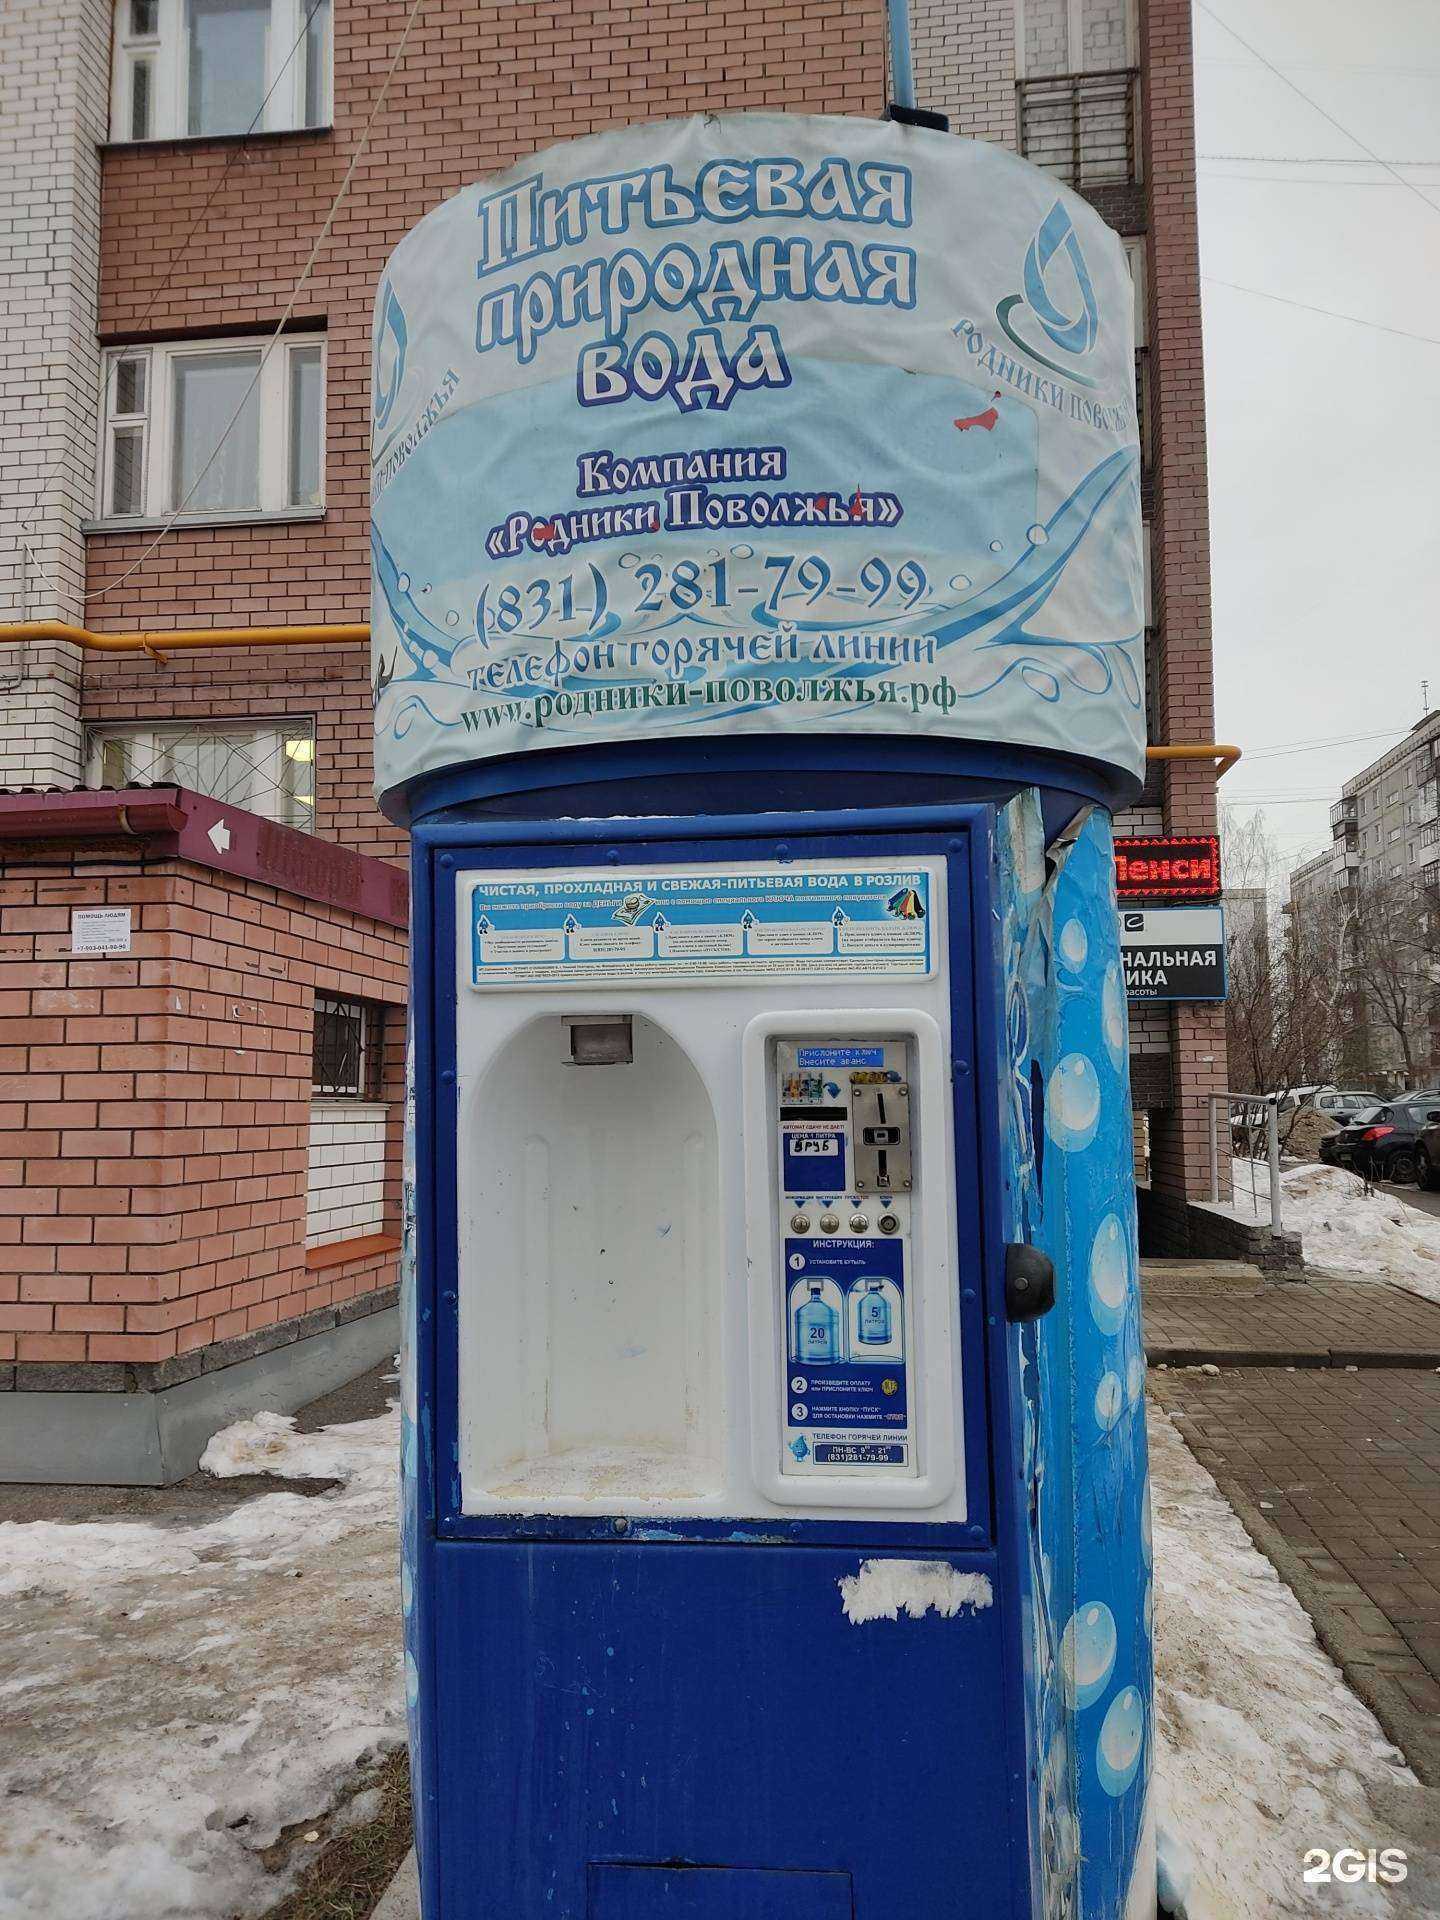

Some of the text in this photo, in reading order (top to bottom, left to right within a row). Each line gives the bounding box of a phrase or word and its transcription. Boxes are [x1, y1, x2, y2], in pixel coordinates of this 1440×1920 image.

[478, 158, 911, 278] Питьевая
[476, 236, 916, 364] природная
[577, 447, 787, 497] Компания
[474, 555, 928, 650] (831) 281-79-99
[467, 622, 937, 692] телефон горячей линии
[460, 675, 958, 734] www.родники-поволжья.рф
[479, 874, 921, 897] ЧИСТАЯ, ПРОХЛАДНАЯ И СВЕЖАЯ-ПИТЬЕВАЯ ВОДА В РОЗЛИВ
[812, 1240, 875, 1250] ИНСТРУКЦИЯ:
[810, 1327, 825, 1339] 20
[871, 1306, 879, 1317] 5
